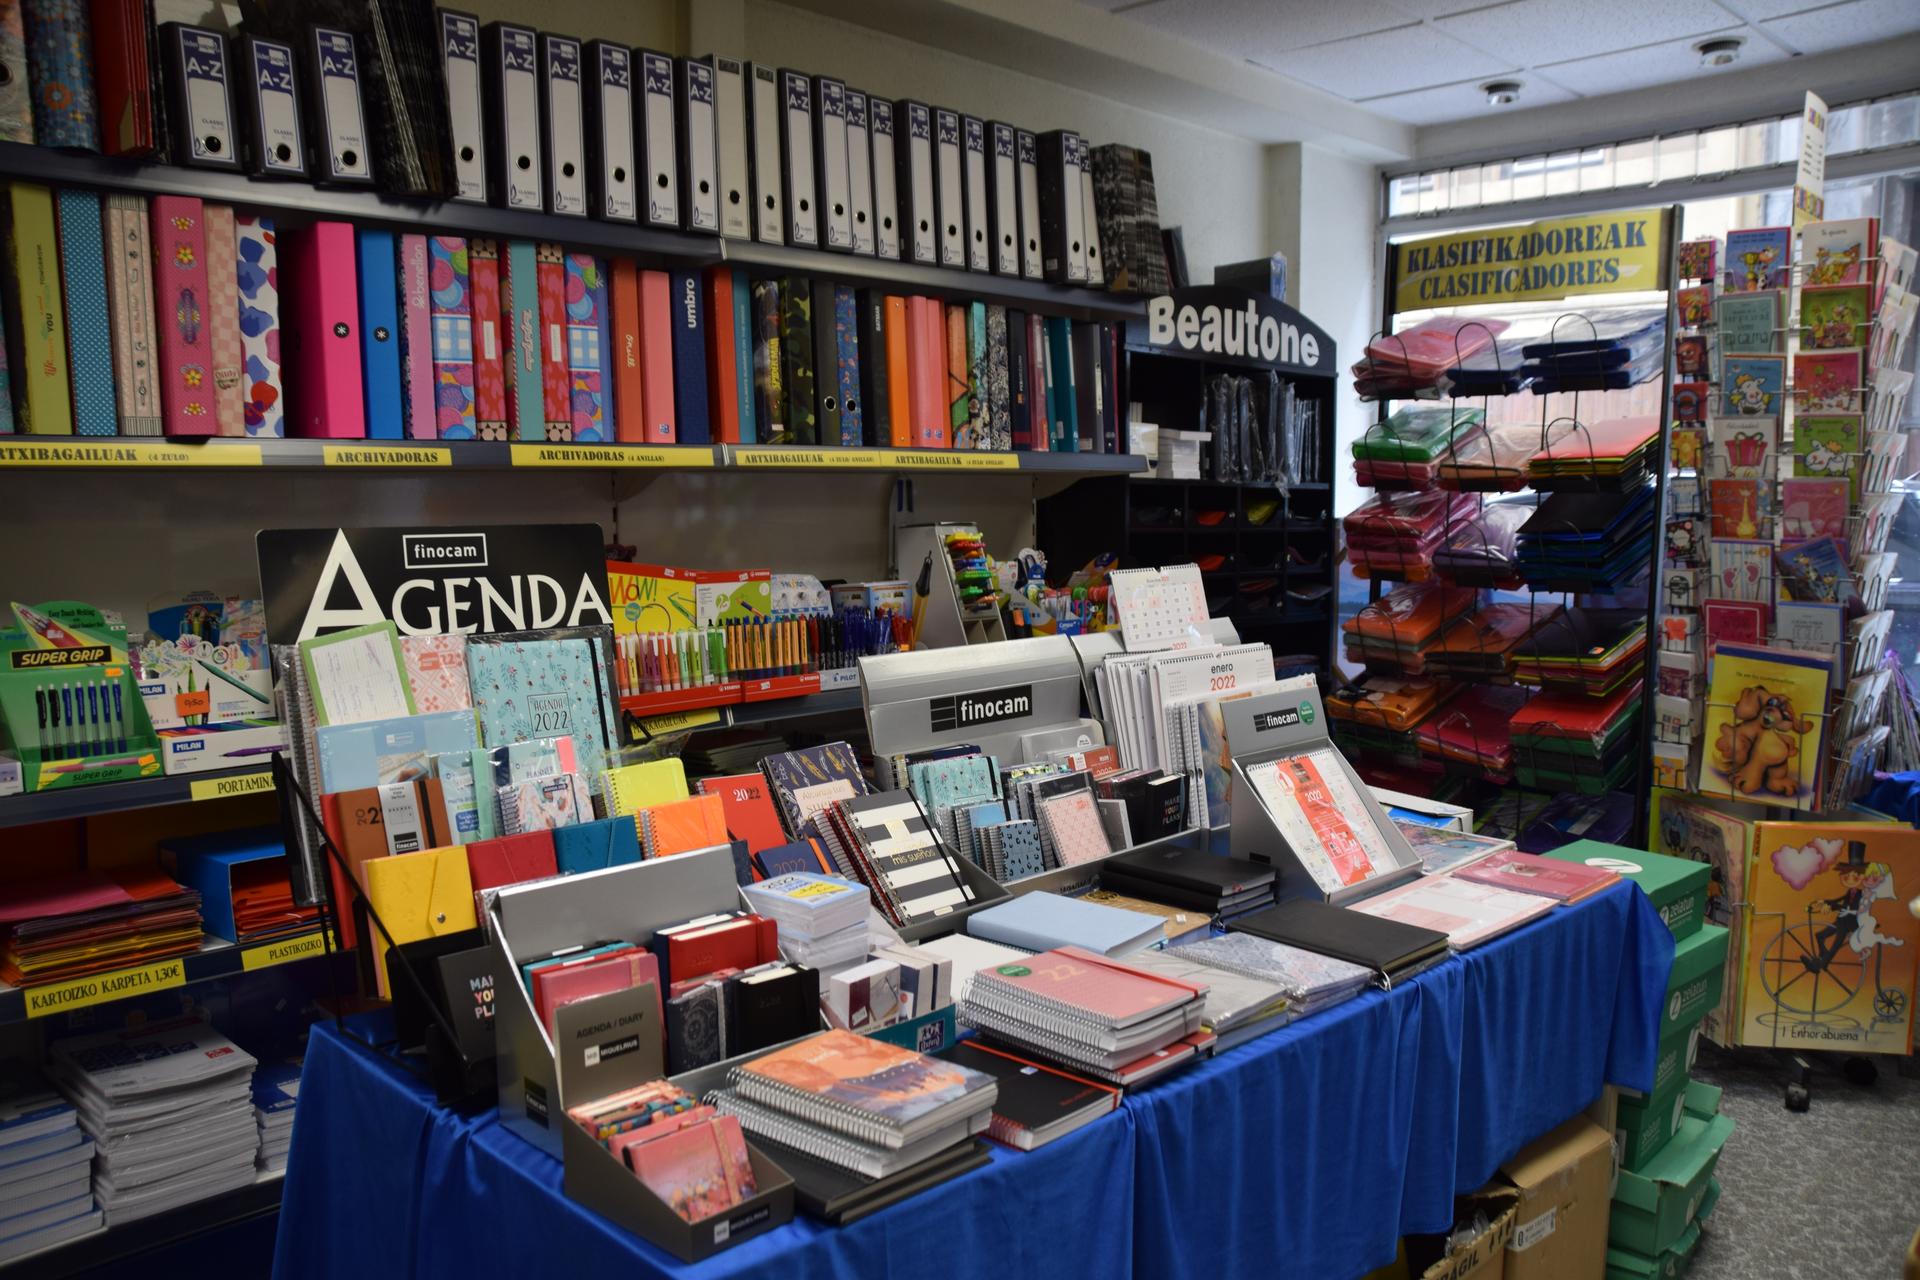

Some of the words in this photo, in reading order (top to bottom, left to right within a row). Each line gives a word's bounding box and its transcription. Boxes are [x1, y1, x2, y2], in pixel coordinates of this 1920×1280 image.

[448, 39, 476, 57] A-Z
[187, 57, 222, 78] A-Z
[323, 56, 354, 75] A-Z
[505, 51, 533, 69] A-Z
[551, 61, 577, 78] A-Z
[603, 68, 628, 85] A-Z
[260, 70, 291, 89] A-Z
[647, 76, 671, 93] A-Z
[690, 84, 711, 100] A-Z
[788, 94, 809, 109] A-Z
[824, 101, 844, 114] A-Z
[846, 110, 865, 124] A-Z
[874, 118, 892, 132] A-Z
[912, 123, 928, 137] A-Z
[940, 132, 957, 143] A-Z
[967, 138, 983, 150] A-Z
[997, 143, 1013, 155] A-Z
[1020, 151, 1035, 162] A-Z
[1407, 220, 1647, 273] KLASIFIKADOREAK
[1419, 257, 1620, 300] CLASIFICADORES
[685, 278, 696, 329] umbro
[1150, 295, 1320, 367] Beautone
[336, 452, 438, 463] ARCHIVADORAS
[538, 450, 624, 462] ARCHIVADORAS
[744, 454, 824, 464] ARTXIBAGAILUAK
[895, 456, 962, 465] ARTXIBAGAILUAK
[414, 544, 477, 559] finocam
[296, 527, 614, 646] AGENDA
[21, 652, 67, 666] SUPER
[70, 649, 104, 661] GRIP
[1211, 662, 1233, 674] enero
[840, 673, 857, 682] PILOT
[1210, 675, 1235, 691] 2022
[534, 699, 564, 712] AGENDA
[960, 695, 1029, 722] finocam
[534, 712, 569, 732] 2022
[1266, 711, 1299, 728] finocam
[176, 741, 202, 751] MILAN
[72, 772, 99, 782] SUPER
[101, 769, 122, 778] GRIP
[733, 788, 761, 801] 2022
[269, 939, 322, 960] PLASTIKOZKO
[32, 984, 98, 1010] KARTOIZKO
[102, 974, 151, 994] KARPETA
[155, 964, 180, 983] 1,30€
[470, 975, 494, 990] MA
[475, 990, 494, 1004] YO
[577, 1023, 612, 1039] AGENDA
[618, 1012, 644, 1027] DIARY
[1791, 1025, 1859, 1041] Enhorabuena
